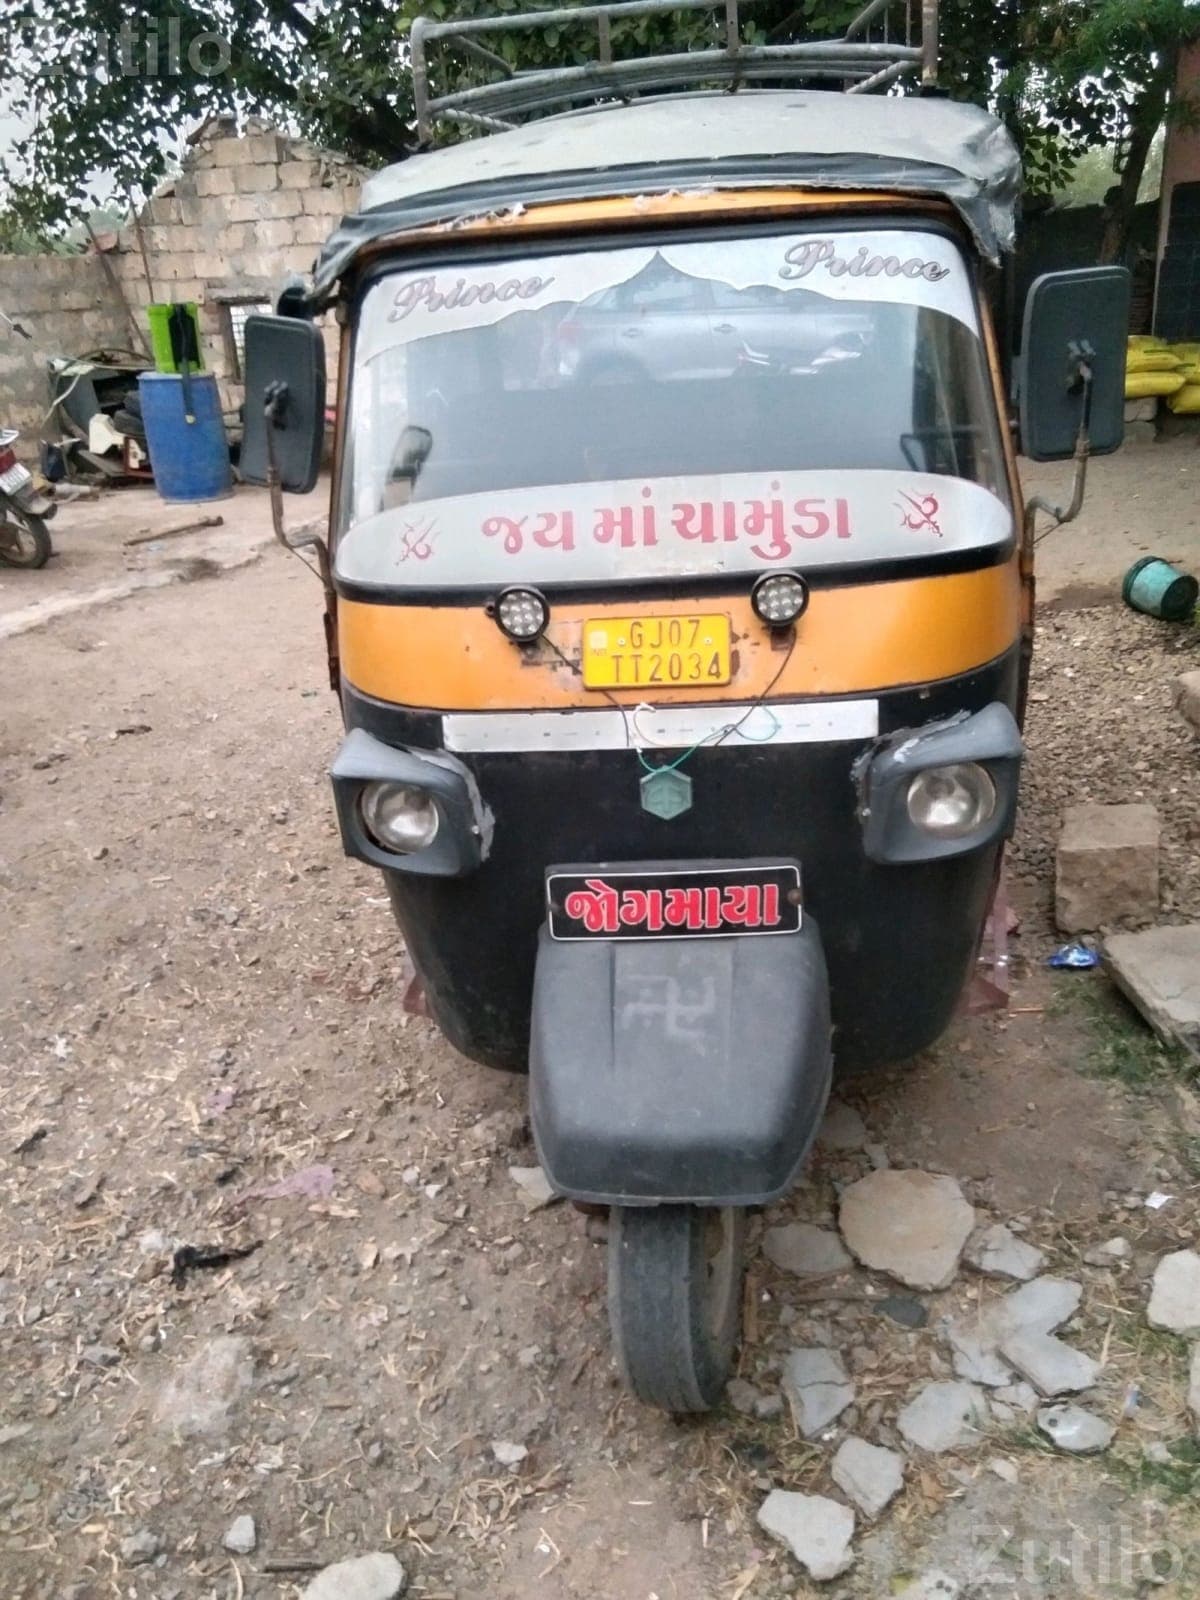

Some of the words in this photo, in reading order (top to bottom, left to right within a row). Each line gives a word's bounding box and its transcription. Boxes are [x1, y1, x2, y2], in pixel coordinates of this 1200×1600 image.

[481, 514, 576, 554] જય
[593, 486, 659, 548] માં
[671, 479, 853, 561] ચામુંડા
[630, 619, 700, 649] GJ07
[611, 651, 721, 683] TT2034
[565, 879, 782, 932] જોગમાયા
